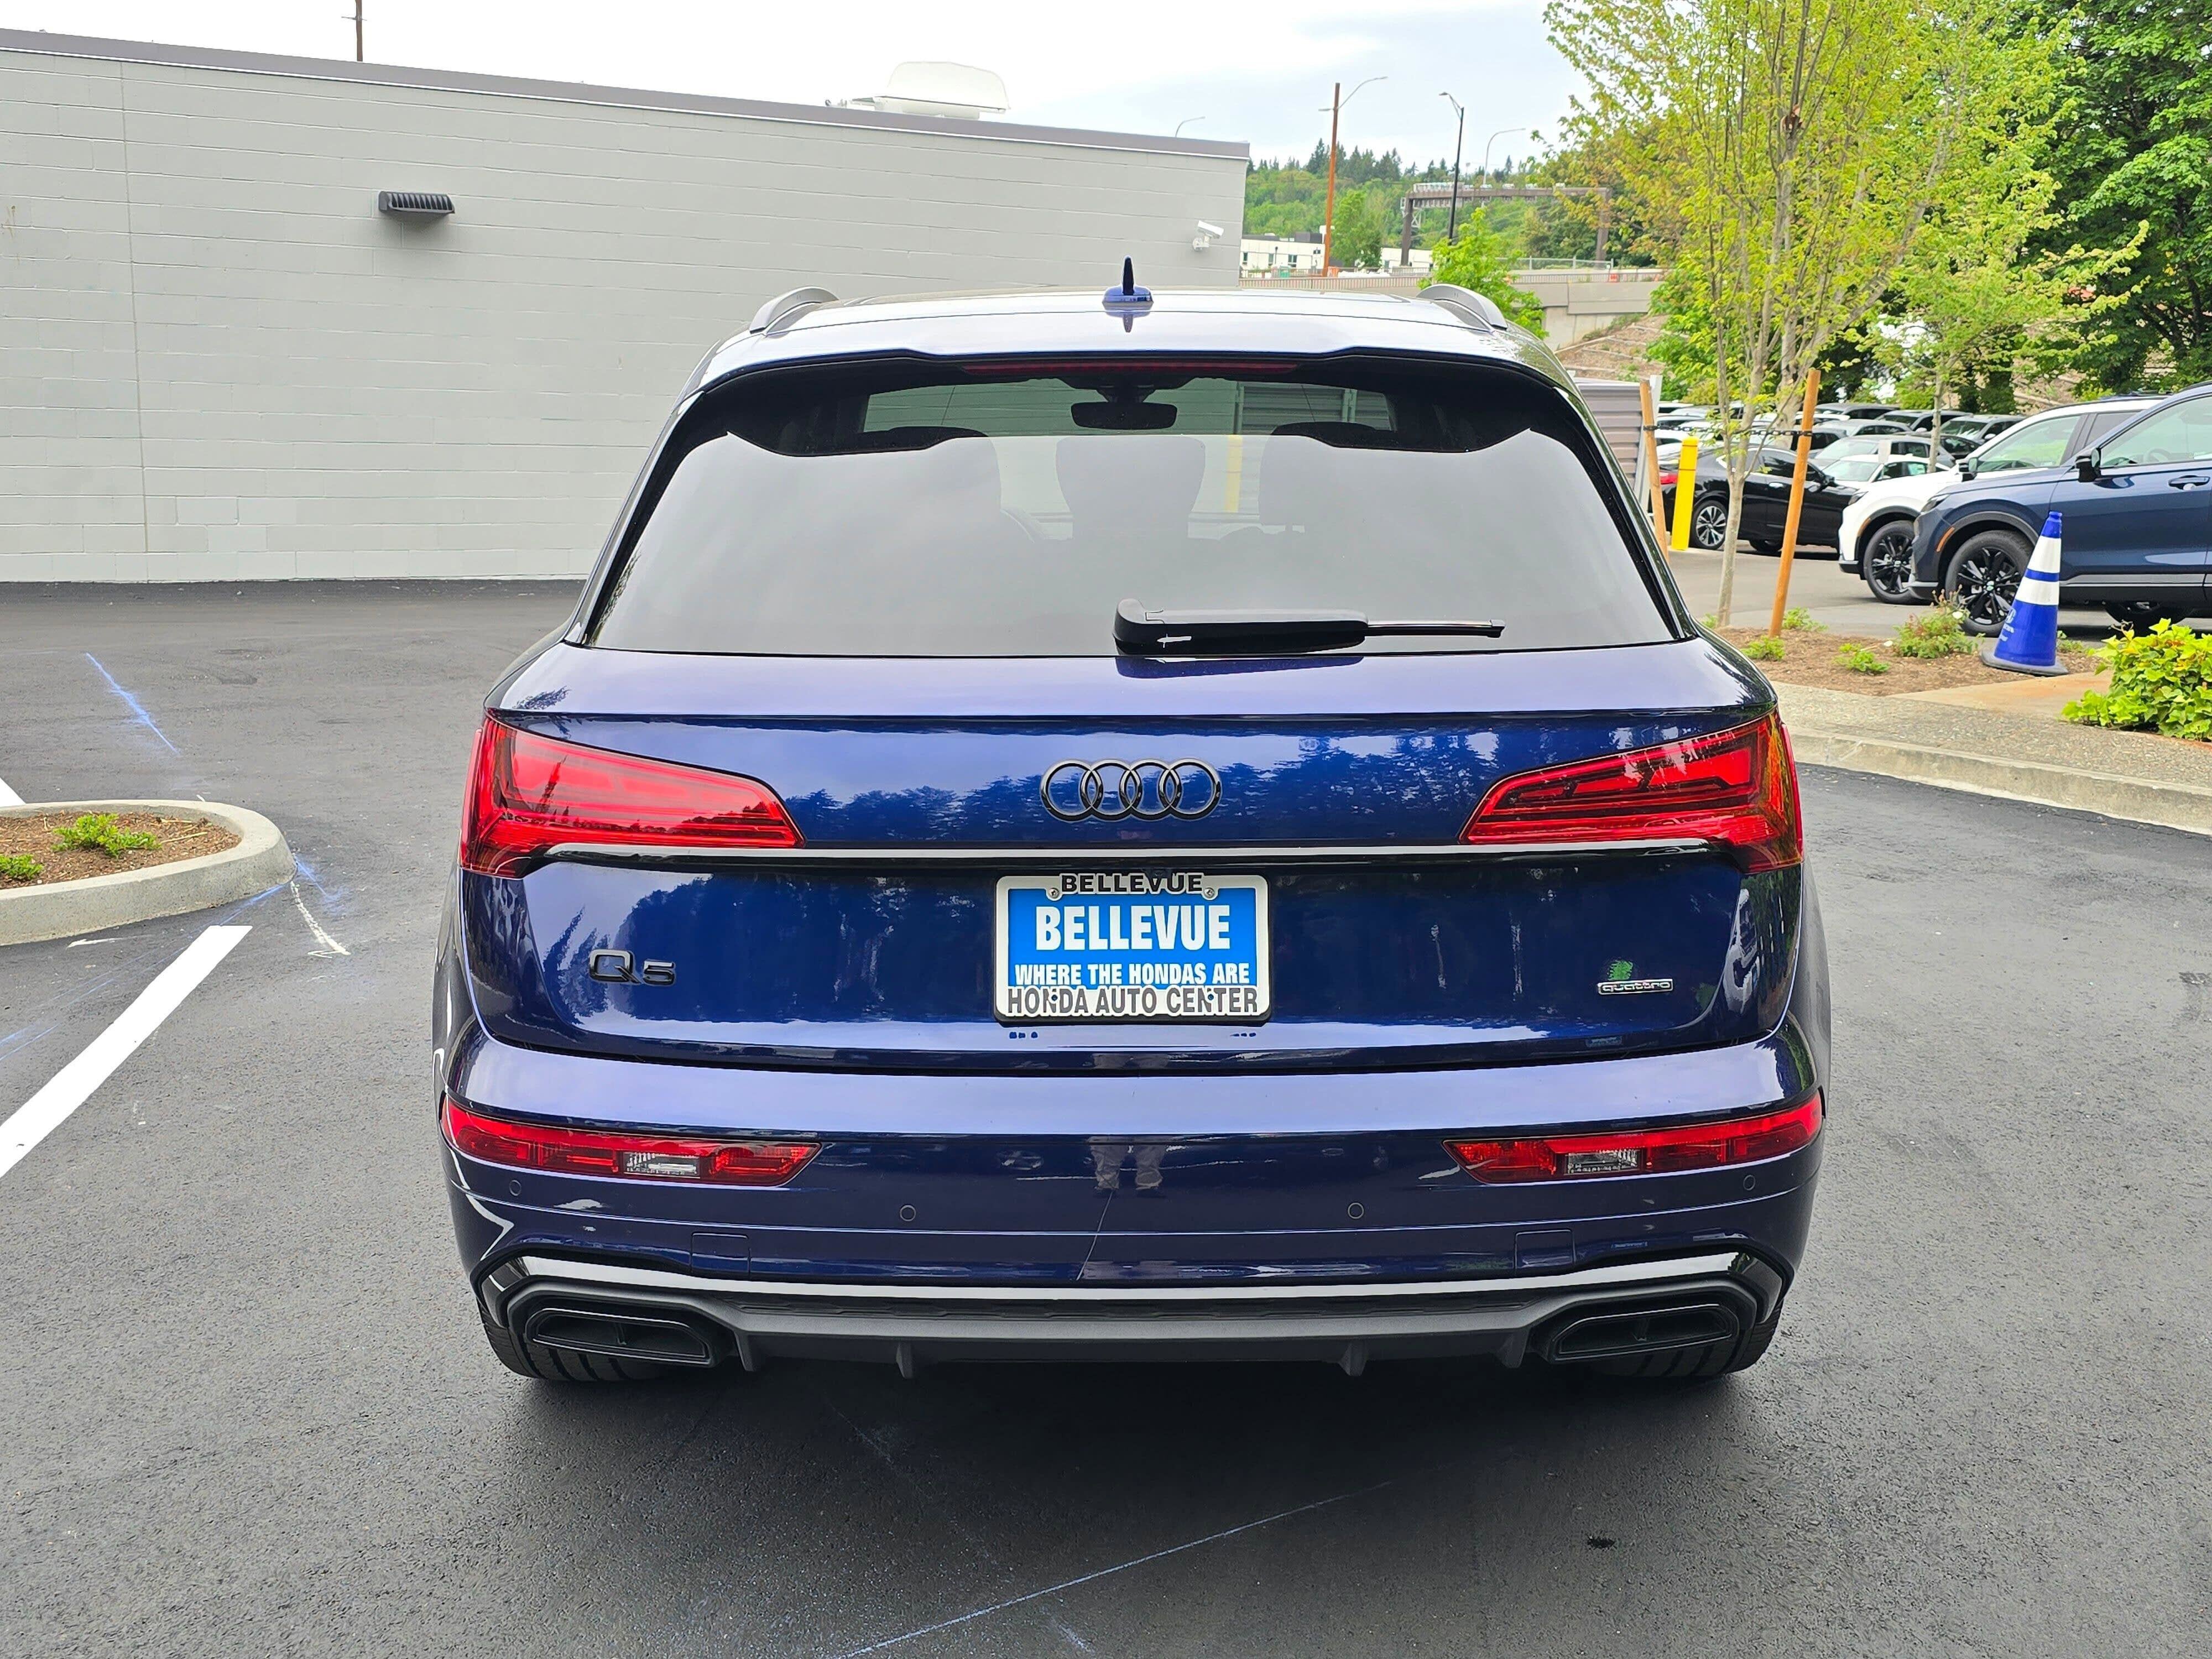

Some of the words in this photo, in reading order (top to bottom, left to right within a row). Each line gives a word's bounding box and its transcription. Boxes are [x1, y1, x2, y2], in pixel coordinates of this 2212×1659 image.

[1061, 874, 1202, 893] BELLEVUE
[1036, 905, 1230, 951] BELLEVUE
[589, 948, 676, 987] Q5
[1014, 964, 1082, 985] WHERE
[1087, 963, 1122, 985] THE
[1129, 963, 1207, 984] HONDAS
[1212, 963, 1250, 984] ARE
[1602, 982, 1671, 992] quattro
[1008, 988, 1089, 1014] HONDA
[1095, 988, 1157, 1013] AUTO
[1166, 987, 1258, 1013] CENTER
